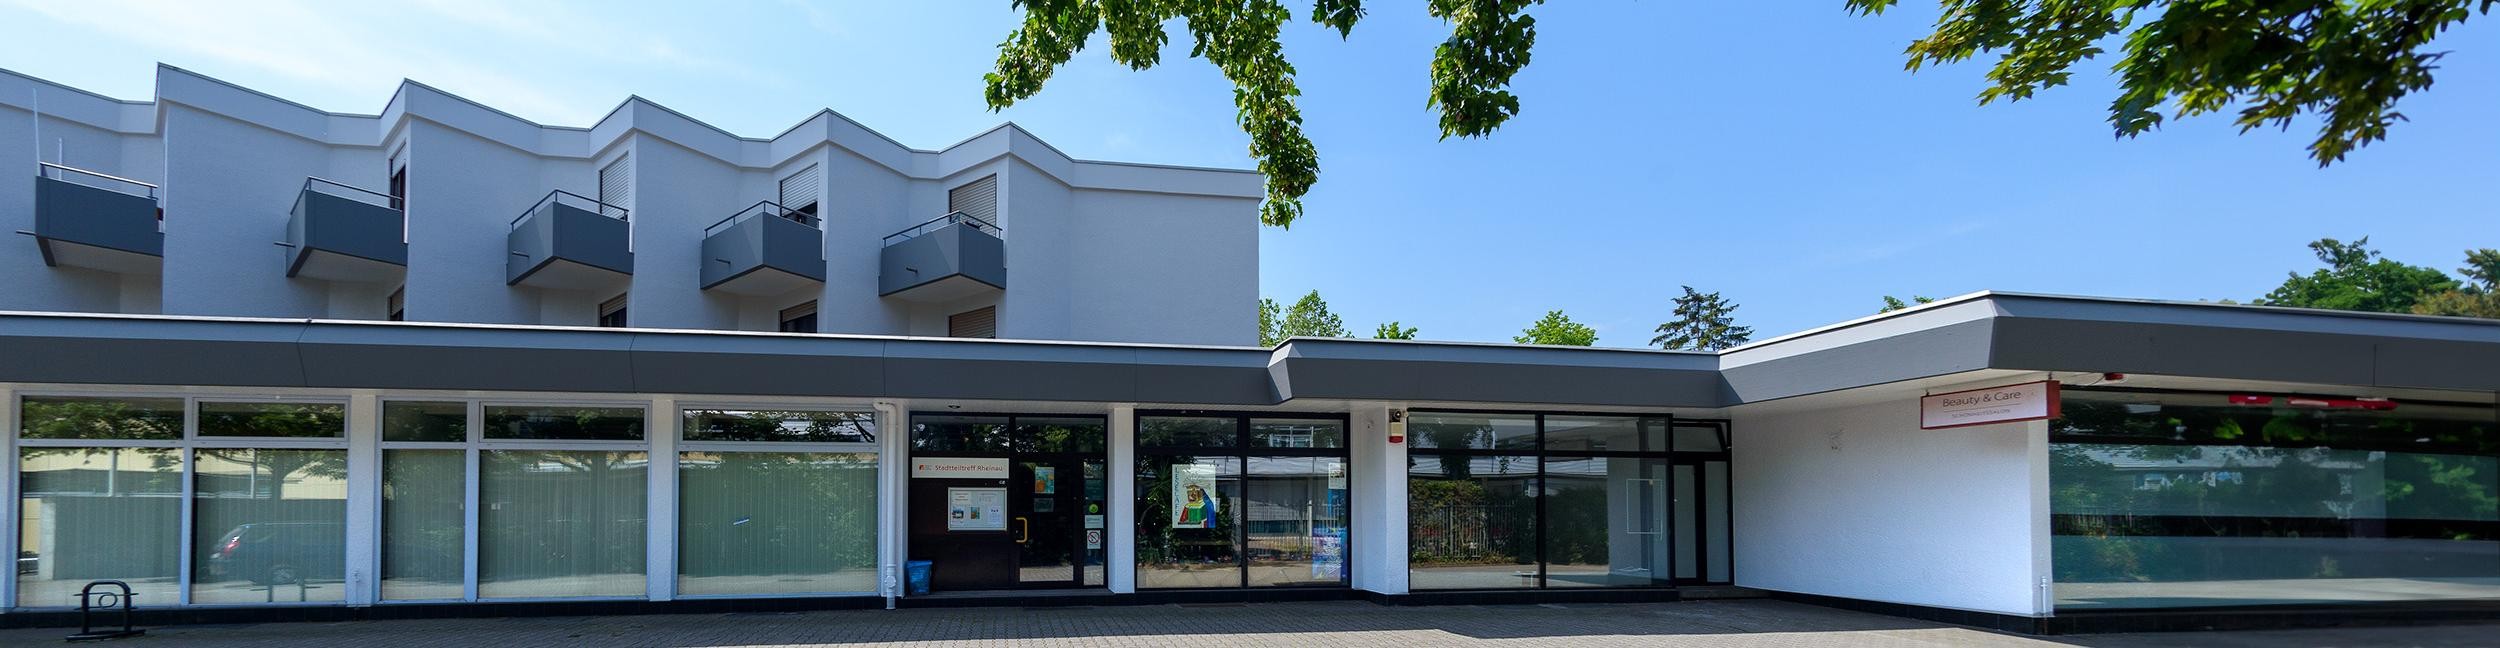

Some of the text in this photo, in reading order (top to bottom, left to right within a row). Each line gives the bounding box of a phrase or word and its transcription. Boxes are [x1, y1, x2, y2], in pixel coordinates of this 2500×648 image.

[1942, 391, 2021, 407] Beauty & Care
[935, 464, 976, 472] Stadtteiltreff
[977, 464, 1003, 472] Rheinau
